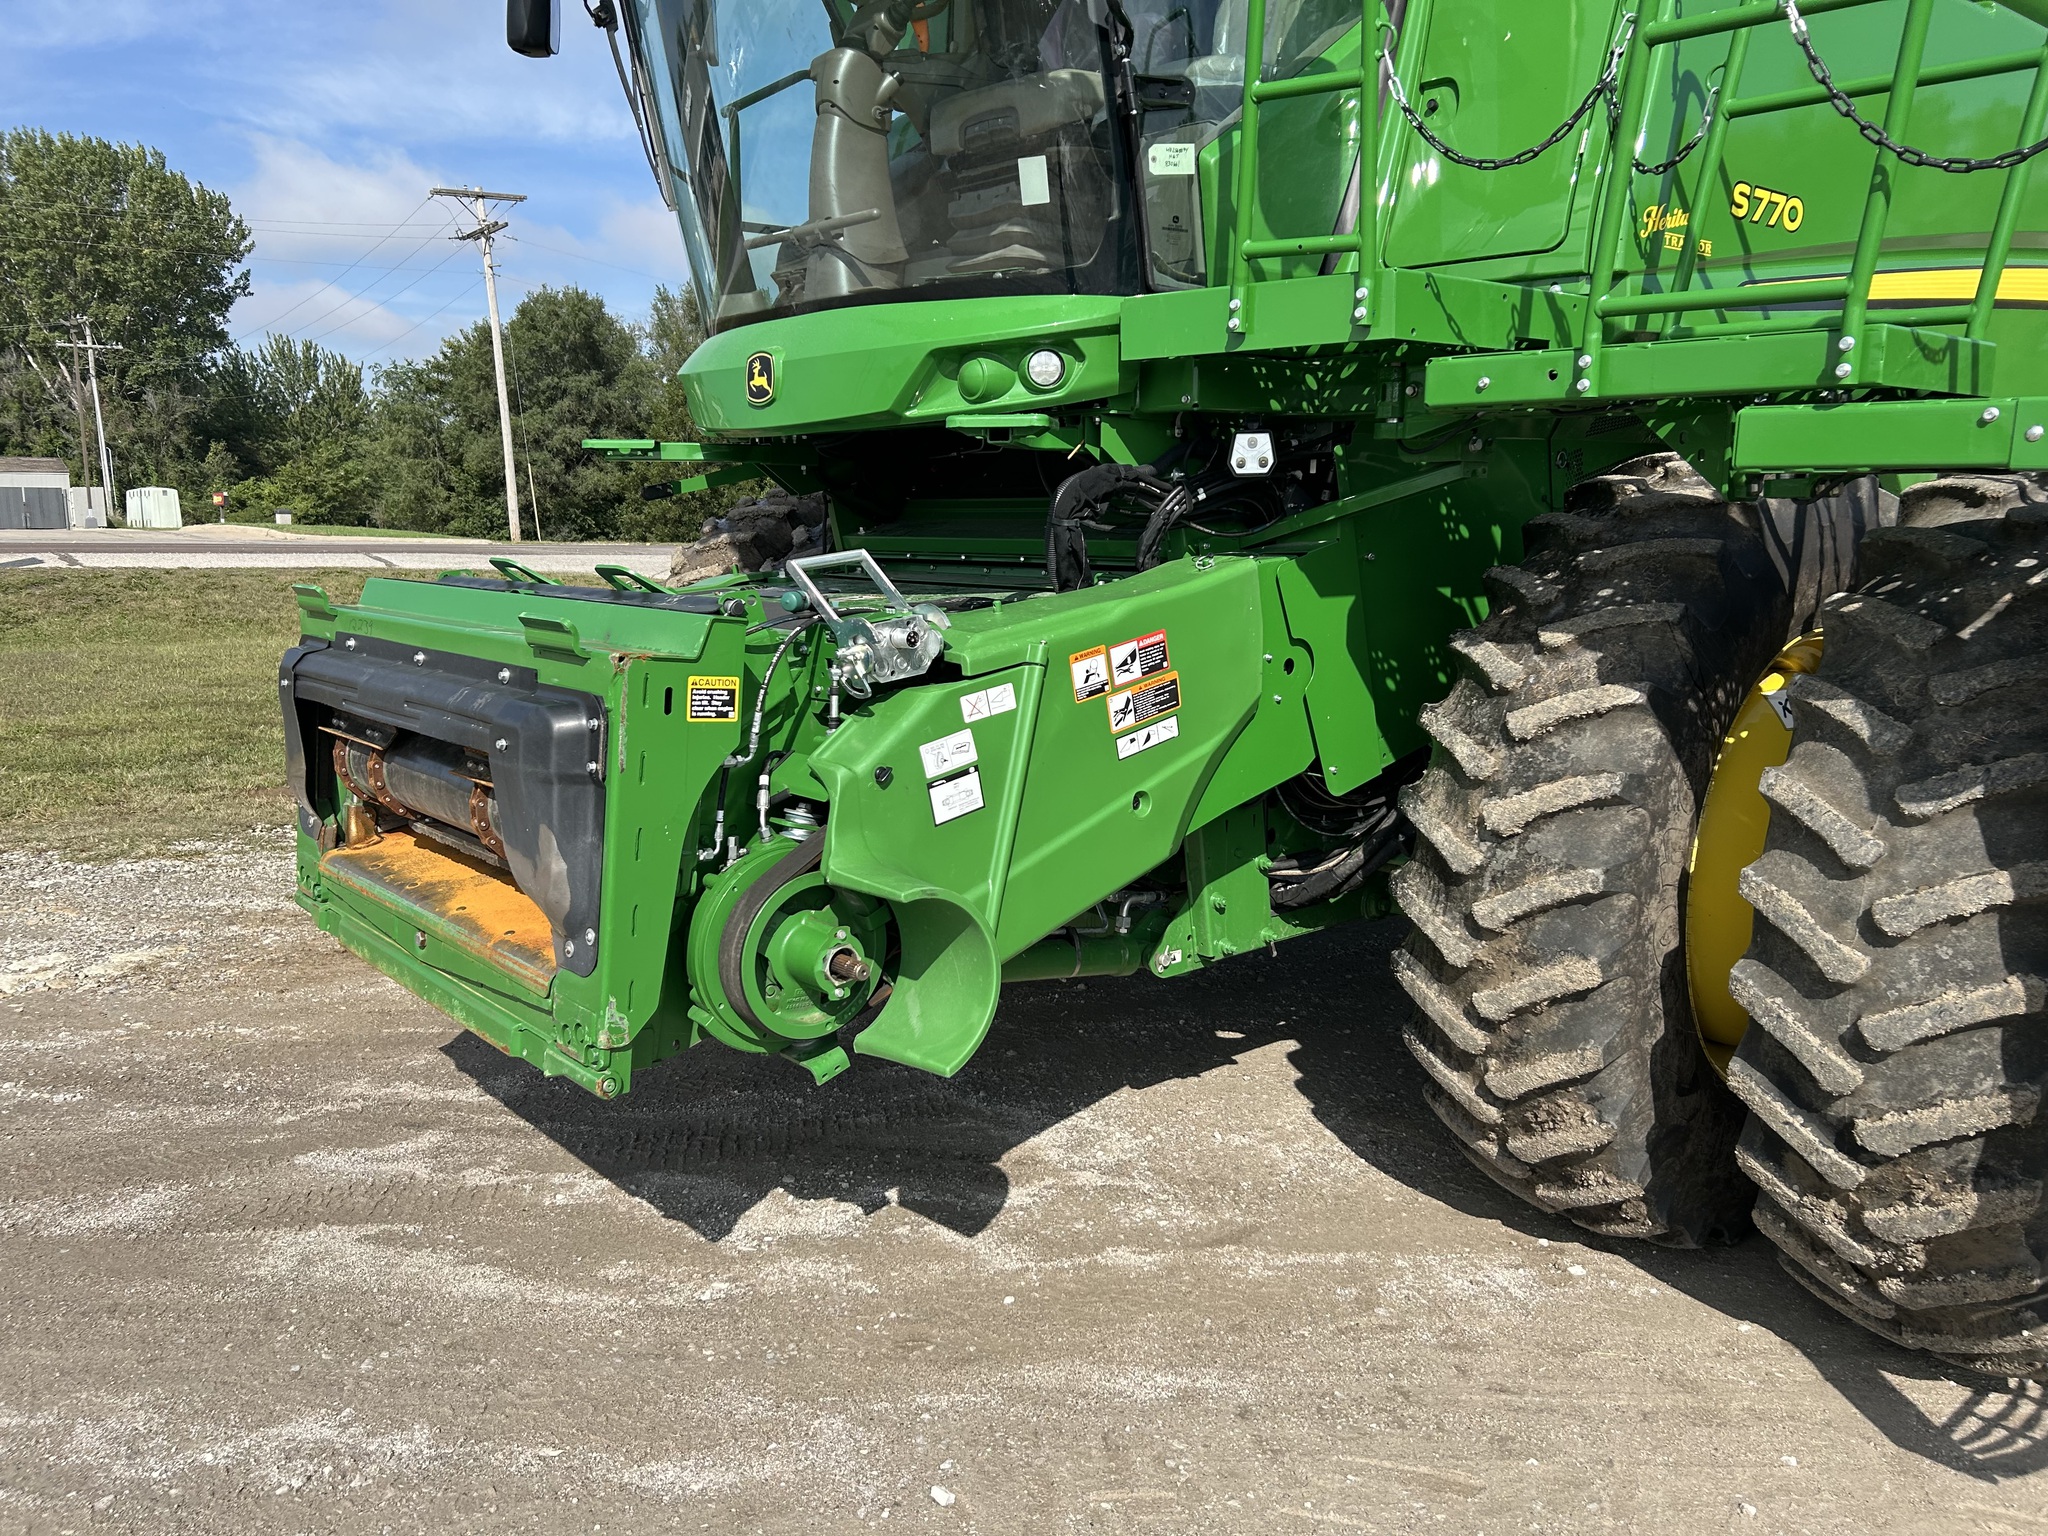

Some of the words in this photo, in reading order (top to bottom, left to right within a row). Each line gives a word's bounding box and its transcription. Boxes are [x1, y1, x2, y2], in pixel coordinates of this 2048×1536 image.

[1730, 180, 1804, 233] S770
[1640, 203, 1690, 238] Herita
[1664, 234, 1712, 254] TRAOR
[1143, 633, 1164, 645] DANGER
[1079, 648, 1101, 658] WARNING
[1144, 676, 1166, 688] WARNING
